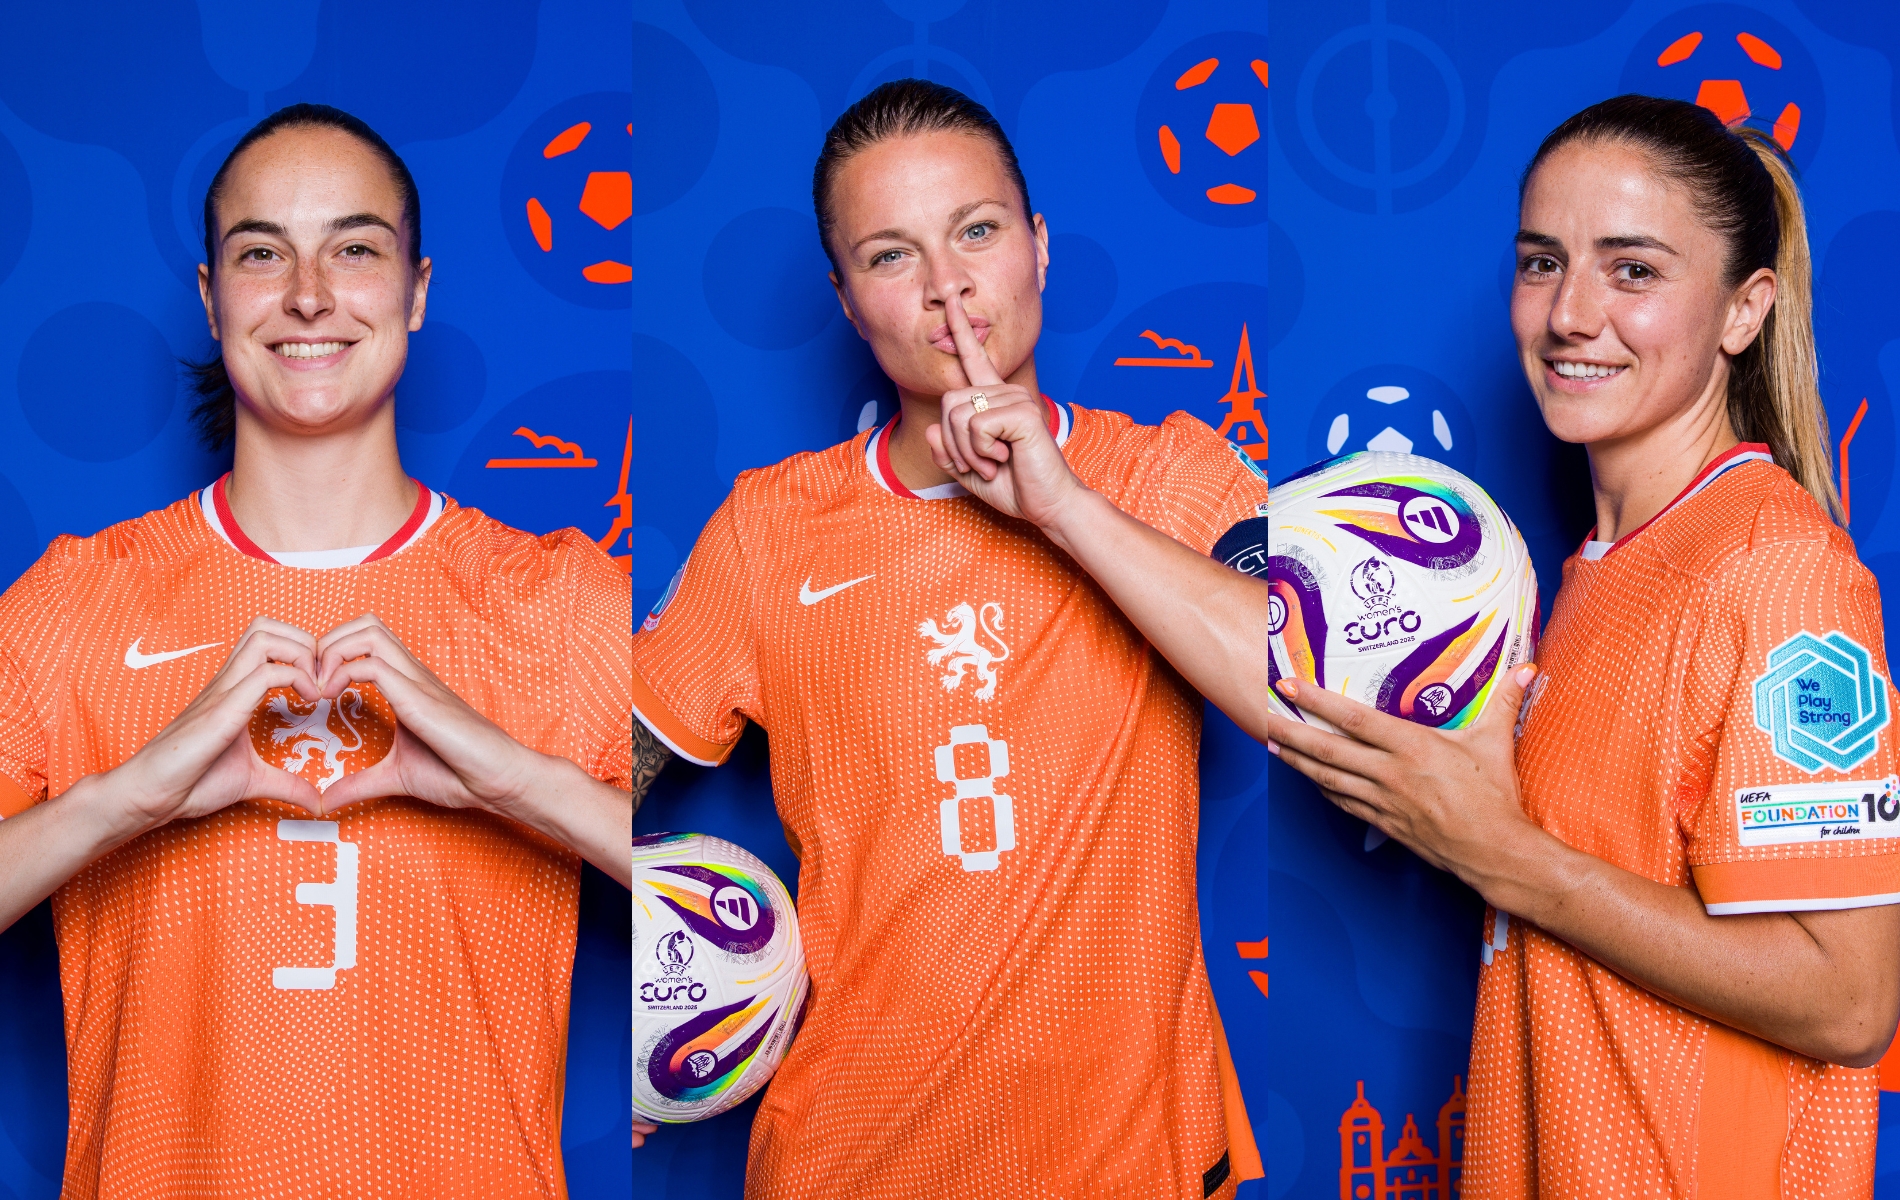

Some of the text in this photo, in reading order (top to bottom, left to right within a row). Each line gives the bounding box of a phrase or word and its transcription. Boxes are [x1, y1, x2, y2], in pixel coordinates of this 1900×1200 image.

[1231, 549, 1266, 573] CT
[1357, 605, 1402, 621] women's
[1358, 636, 1416, 652] SWITZERLAND 2025
[1797, 678, 1820, 691] We
[1798, 694, 1832, 712] Play
[1799, 710, 1851, 726] Strong
[934, 724, 1015, 872] 8
[1740, 792, 1771, 803] UEFA
[1820, 826, 1860, 838] for children
[272, 819, 359, 990] 3
